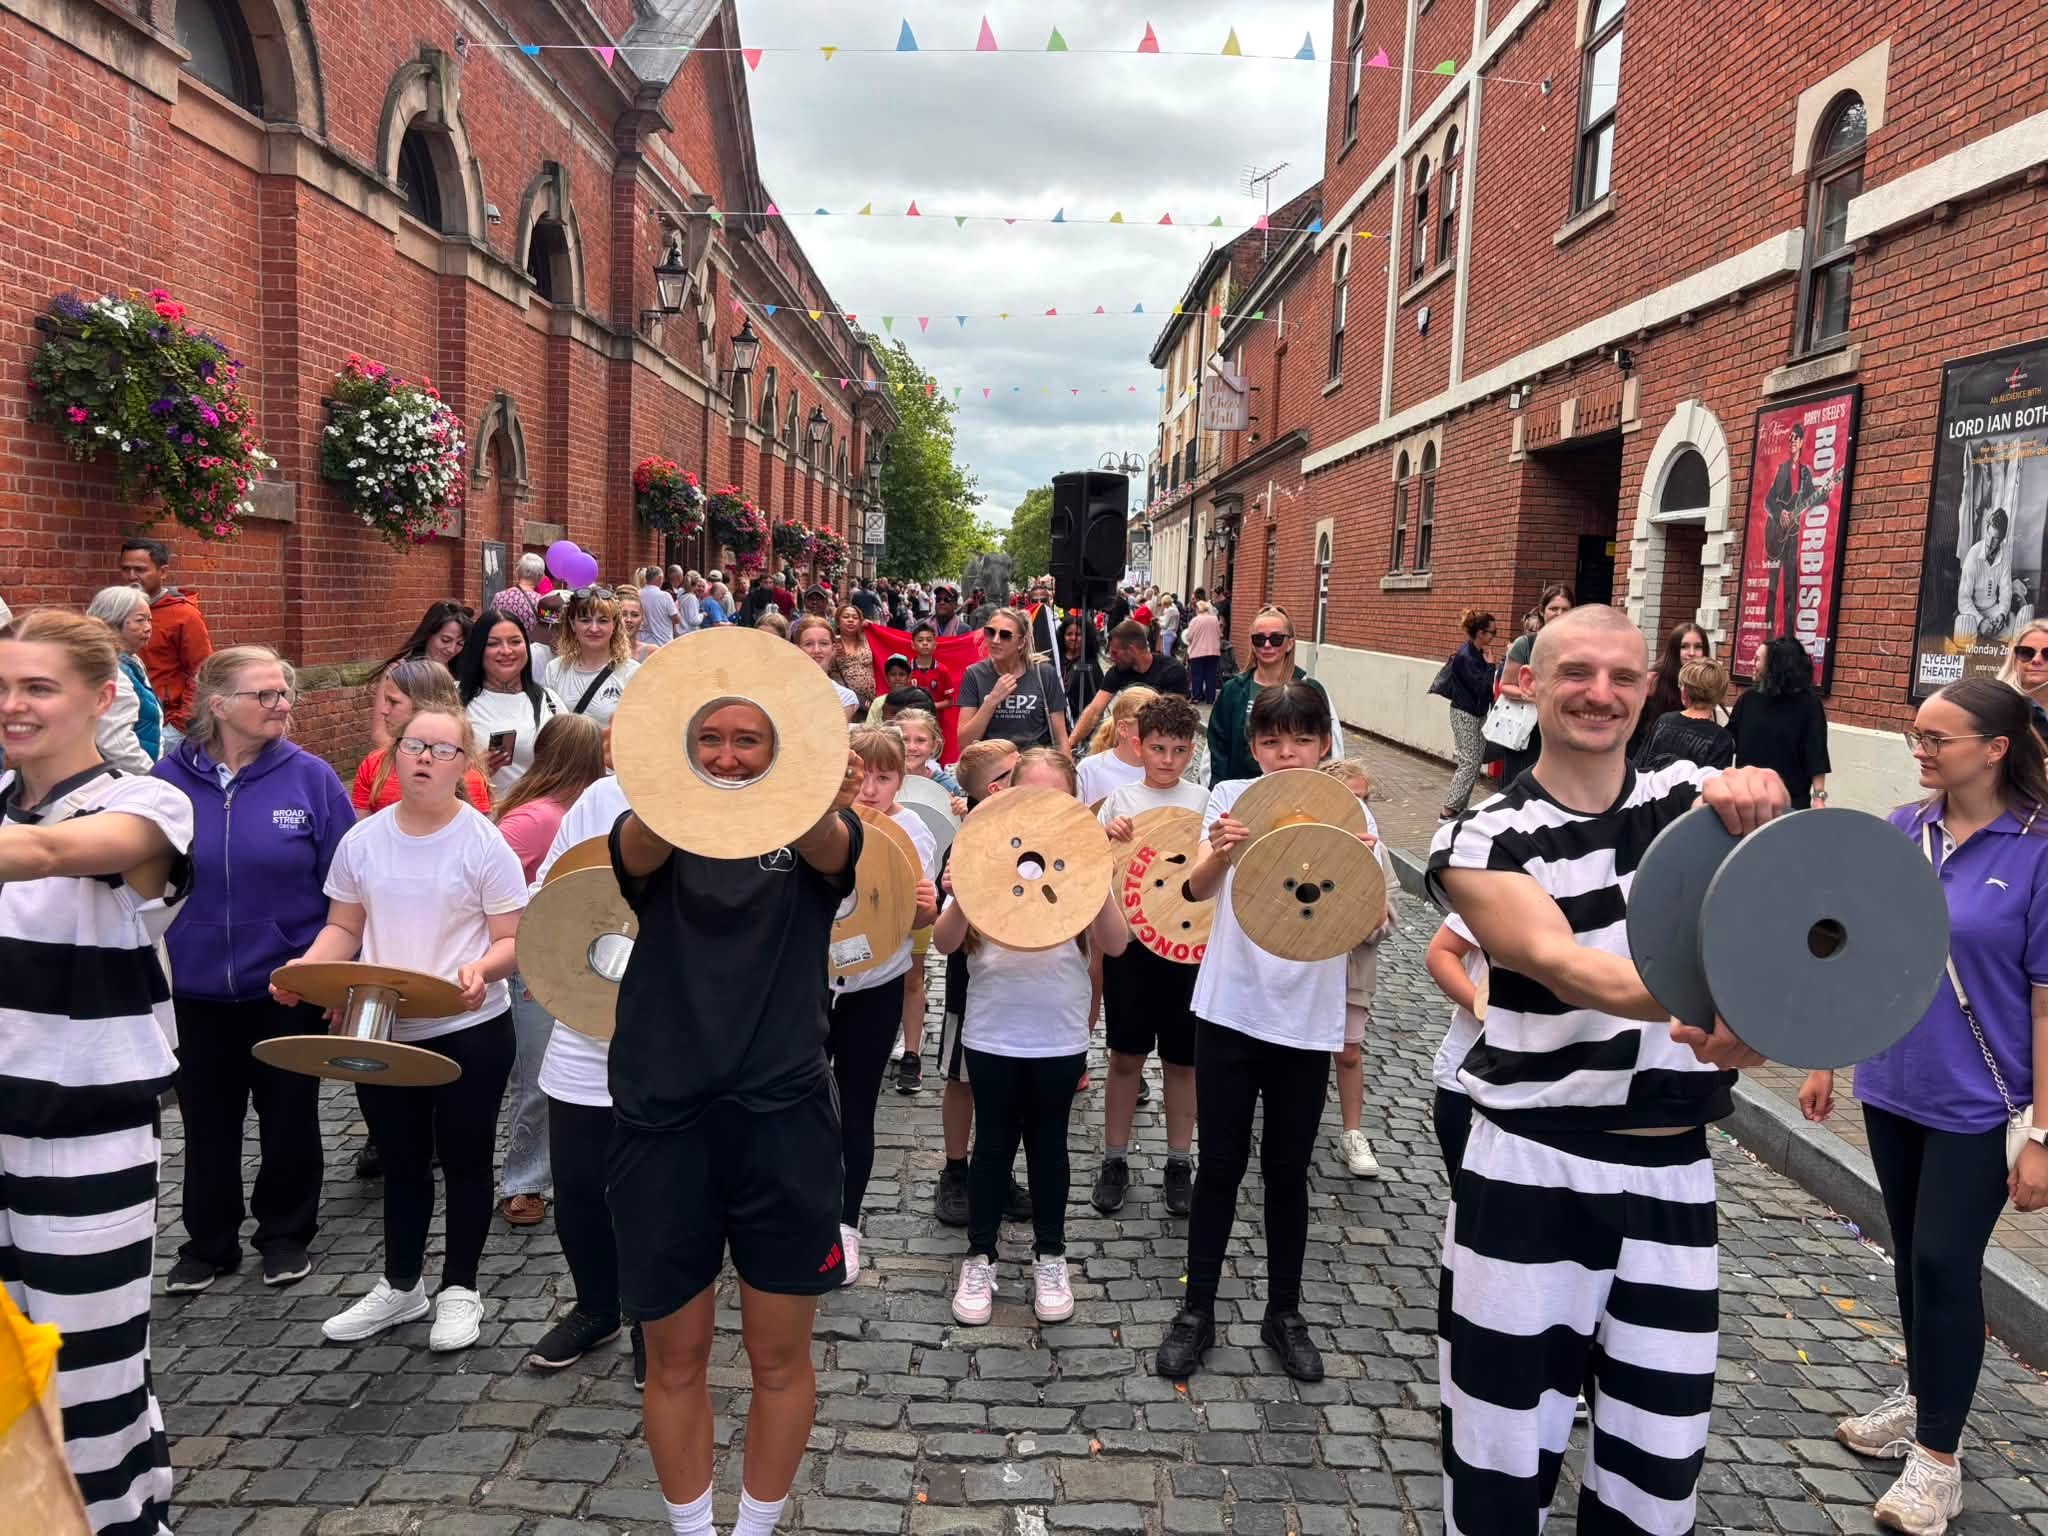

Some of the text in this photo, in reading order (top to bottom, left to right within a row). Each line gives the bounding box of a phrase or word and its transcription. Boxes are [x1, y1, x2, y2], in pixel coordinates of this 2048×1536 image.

[1949, 417, 1984, 440] LORD
[1987, 411, 2012, 433] IAN
[1965, 643, 2011, 657] Monday 2n
[1924, 655, 1961, 667] LYCEUM
[1921, 665, 1962, 679] THEATRE
[272, 816, 306, 824] STREET
[1124, 845, 1208, 961] DONCASTER
